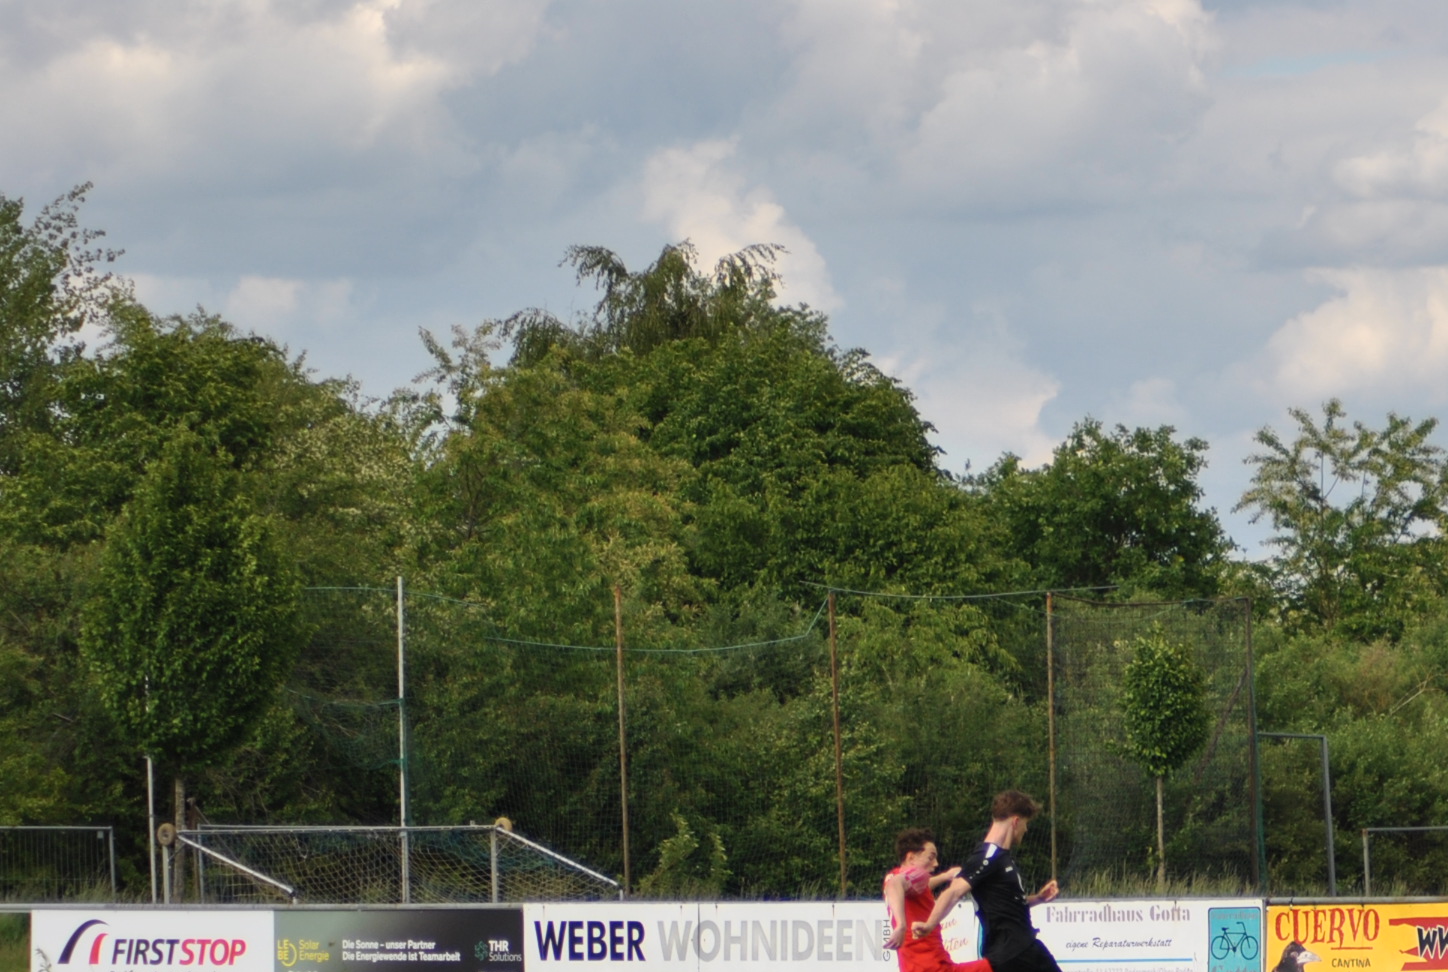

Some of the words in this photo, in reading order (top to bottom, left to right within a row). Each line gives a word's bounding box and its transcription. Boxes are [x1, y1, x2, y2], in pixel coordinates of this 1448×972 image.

[1046, 904, 1144, 923] Fahrradhaus
[1149, 904, 1191, 922] Gotta
[1275, 908, 1380, 949] CUERVO
[299, 940, 320, 950] Solar
[342, 940, 355, 950] Die
[356, 940, 379, 950] Sonne
[385, 941, 407, 950] unser
[407, 940, 436, 950] Partner
[488, 940, 509, 952] THR
[534, 920, 646, 962] WEBER
[657, 919, 883, 962] WOHNIDEEN
[1065, 939, 1089, 951] eigene
[1092, 937, 1172, 949] Reparaturwerkstatt
[300, 951, 330, 963] Energie
[342, 951, 355, 961] Die
[356, 951, 407, 963] Energiewende
[408, 951, 418, 961] ist
[419, 951, 461, 962] Teamarbeit
[489, 951, 522, 962] Solutions
[1331, 958, 1371, 968] CANTINA
